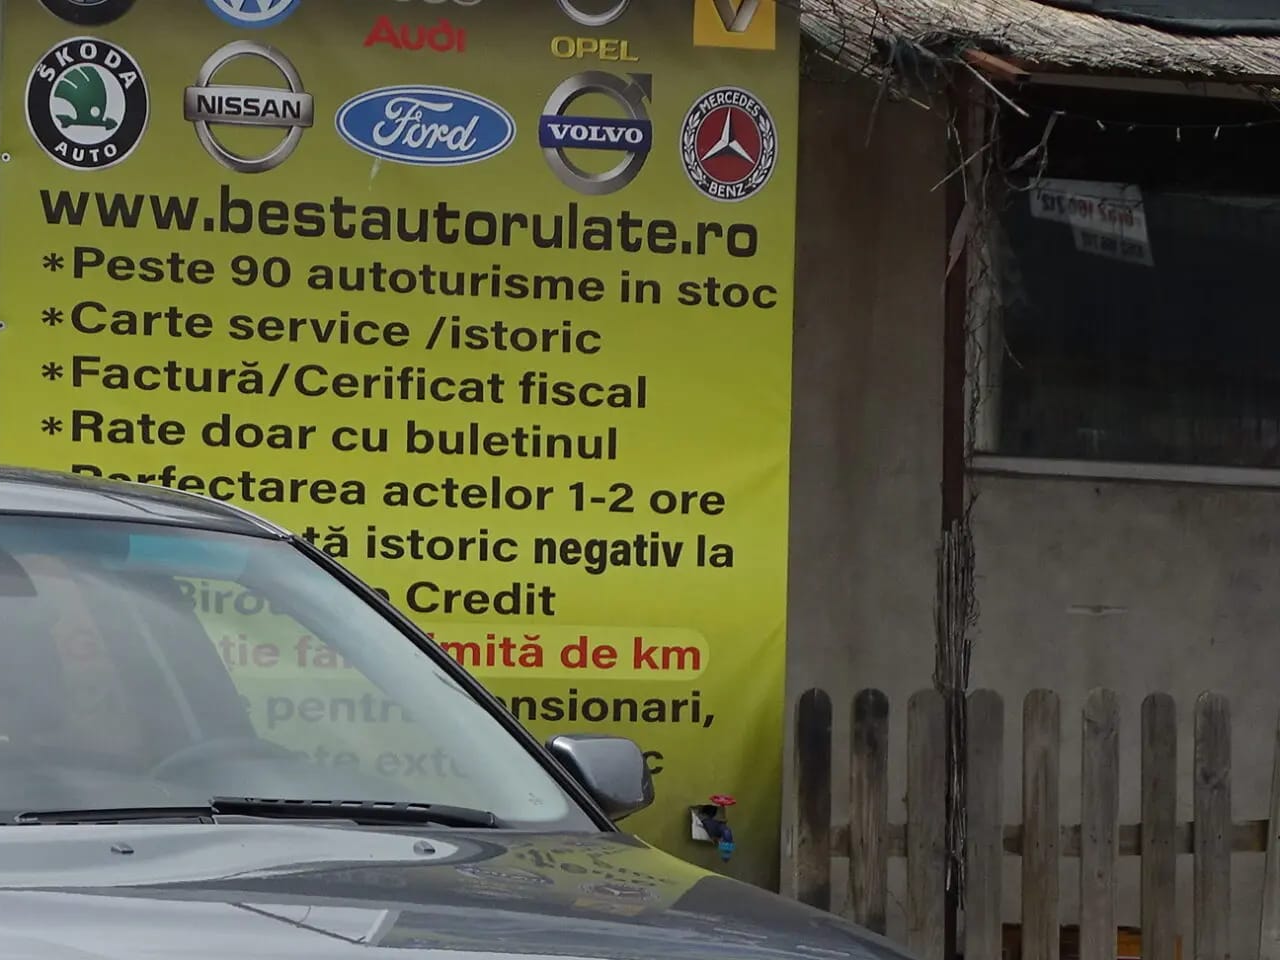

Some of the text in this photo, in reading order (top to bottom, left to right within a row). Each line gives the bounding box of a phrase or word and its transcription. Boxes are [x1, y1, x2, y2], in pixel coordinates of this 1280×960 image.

[363, 15, 467, 52] Audi
[550, 36, 640, 62] OPEL
[196, 94, 302, 120] NISSAN
[699, 91, 761, 117] MERCEDES
[372, 96, 481, 152] Ford
[547, 123, 644, 144] VOLVO
[54, 141, 118, 162] AUTO
[708, 181, 746, 198] BENZ
[39, 185, 758, 258] www.bestautorulate.ro
[231, 255, 290, 287] 90
[308, 262, 604, 302] autoturisme
[621, 271, 660, 304] in
[678, 277, 777, 309] stoc
[229, 311, 409, 346] service
[519, 372, 646, 409] fiscal
[202, 414, 317, 450] doar
[332, 427, 387, 452] cu
[407, 421, 617, 460] buletinul
[384, 476, 554, 511] actelor
[570, 482, 634, 512] 1-2
[650, 491, 726, 516] ore
[368, 526, 518, 563] istoric
[535, 532, 684, 575] negativ
[698, 535, 734, 568] la
[407, 582, 556, 616] Credit
[560, 636, 617, 670] de
[633, 637, 701, 671] km
